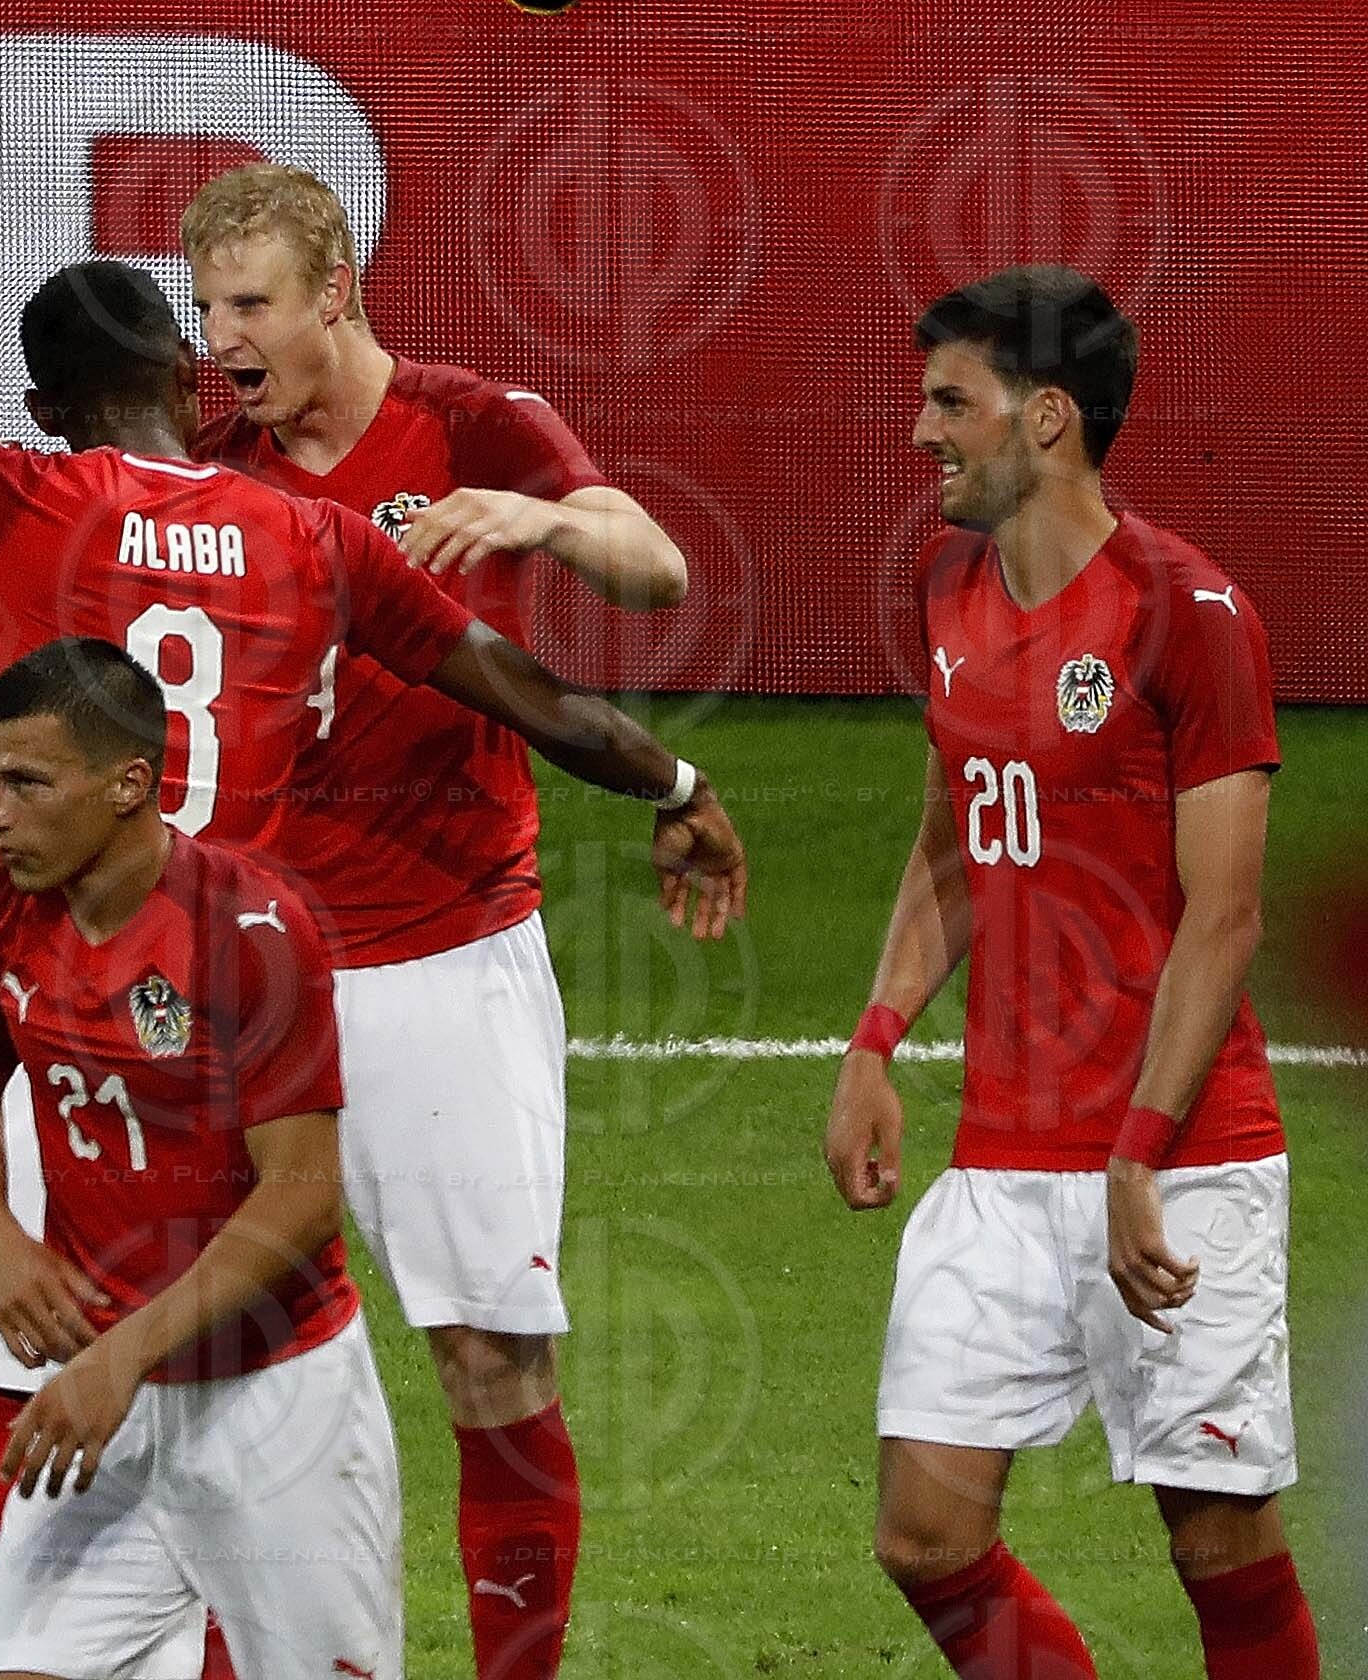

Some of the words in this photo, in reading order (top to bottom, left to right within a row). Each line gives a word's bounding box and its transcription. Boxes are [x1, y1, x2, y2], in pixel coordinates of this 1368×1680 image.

[118, 511, 247, 577] ALABA
[126, 603, 224, 838] 8
[963, 757, 1042, 867] 20
[47, 1062, 149, 1171] 21
